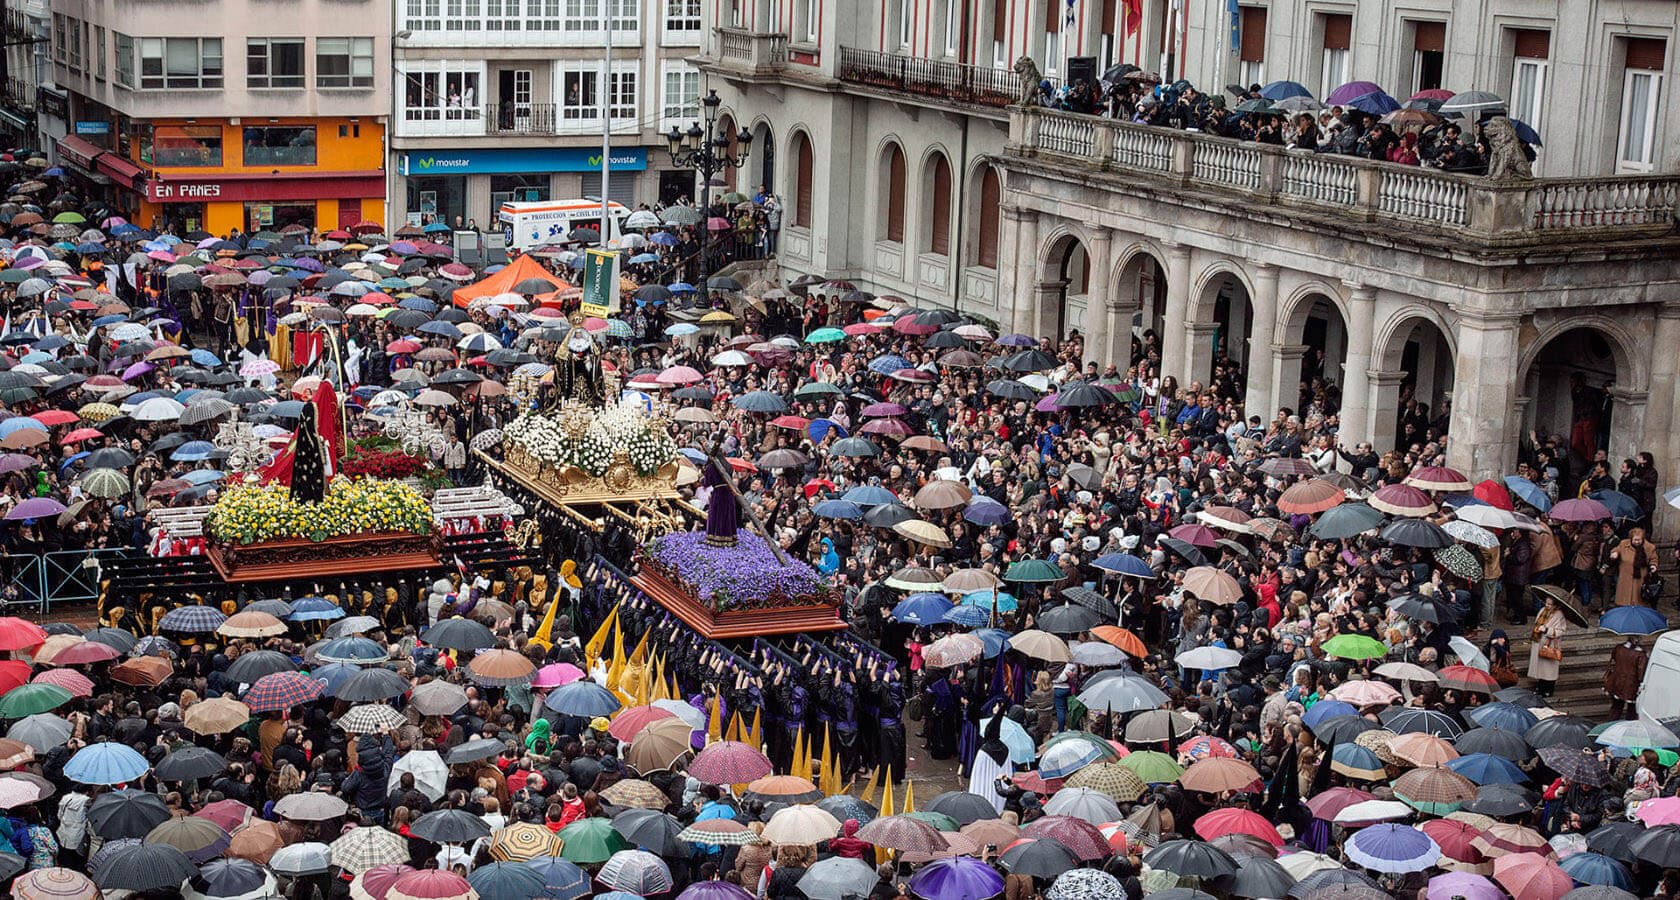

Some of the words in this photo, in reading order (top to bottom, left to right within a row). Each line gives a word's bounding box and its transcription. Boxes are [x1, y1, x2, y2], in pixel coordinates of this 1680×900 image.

[436, 159, 470, 167] movistar
[155, 185, 173, 197] EN
[180, 184, 220, 197] PANES
